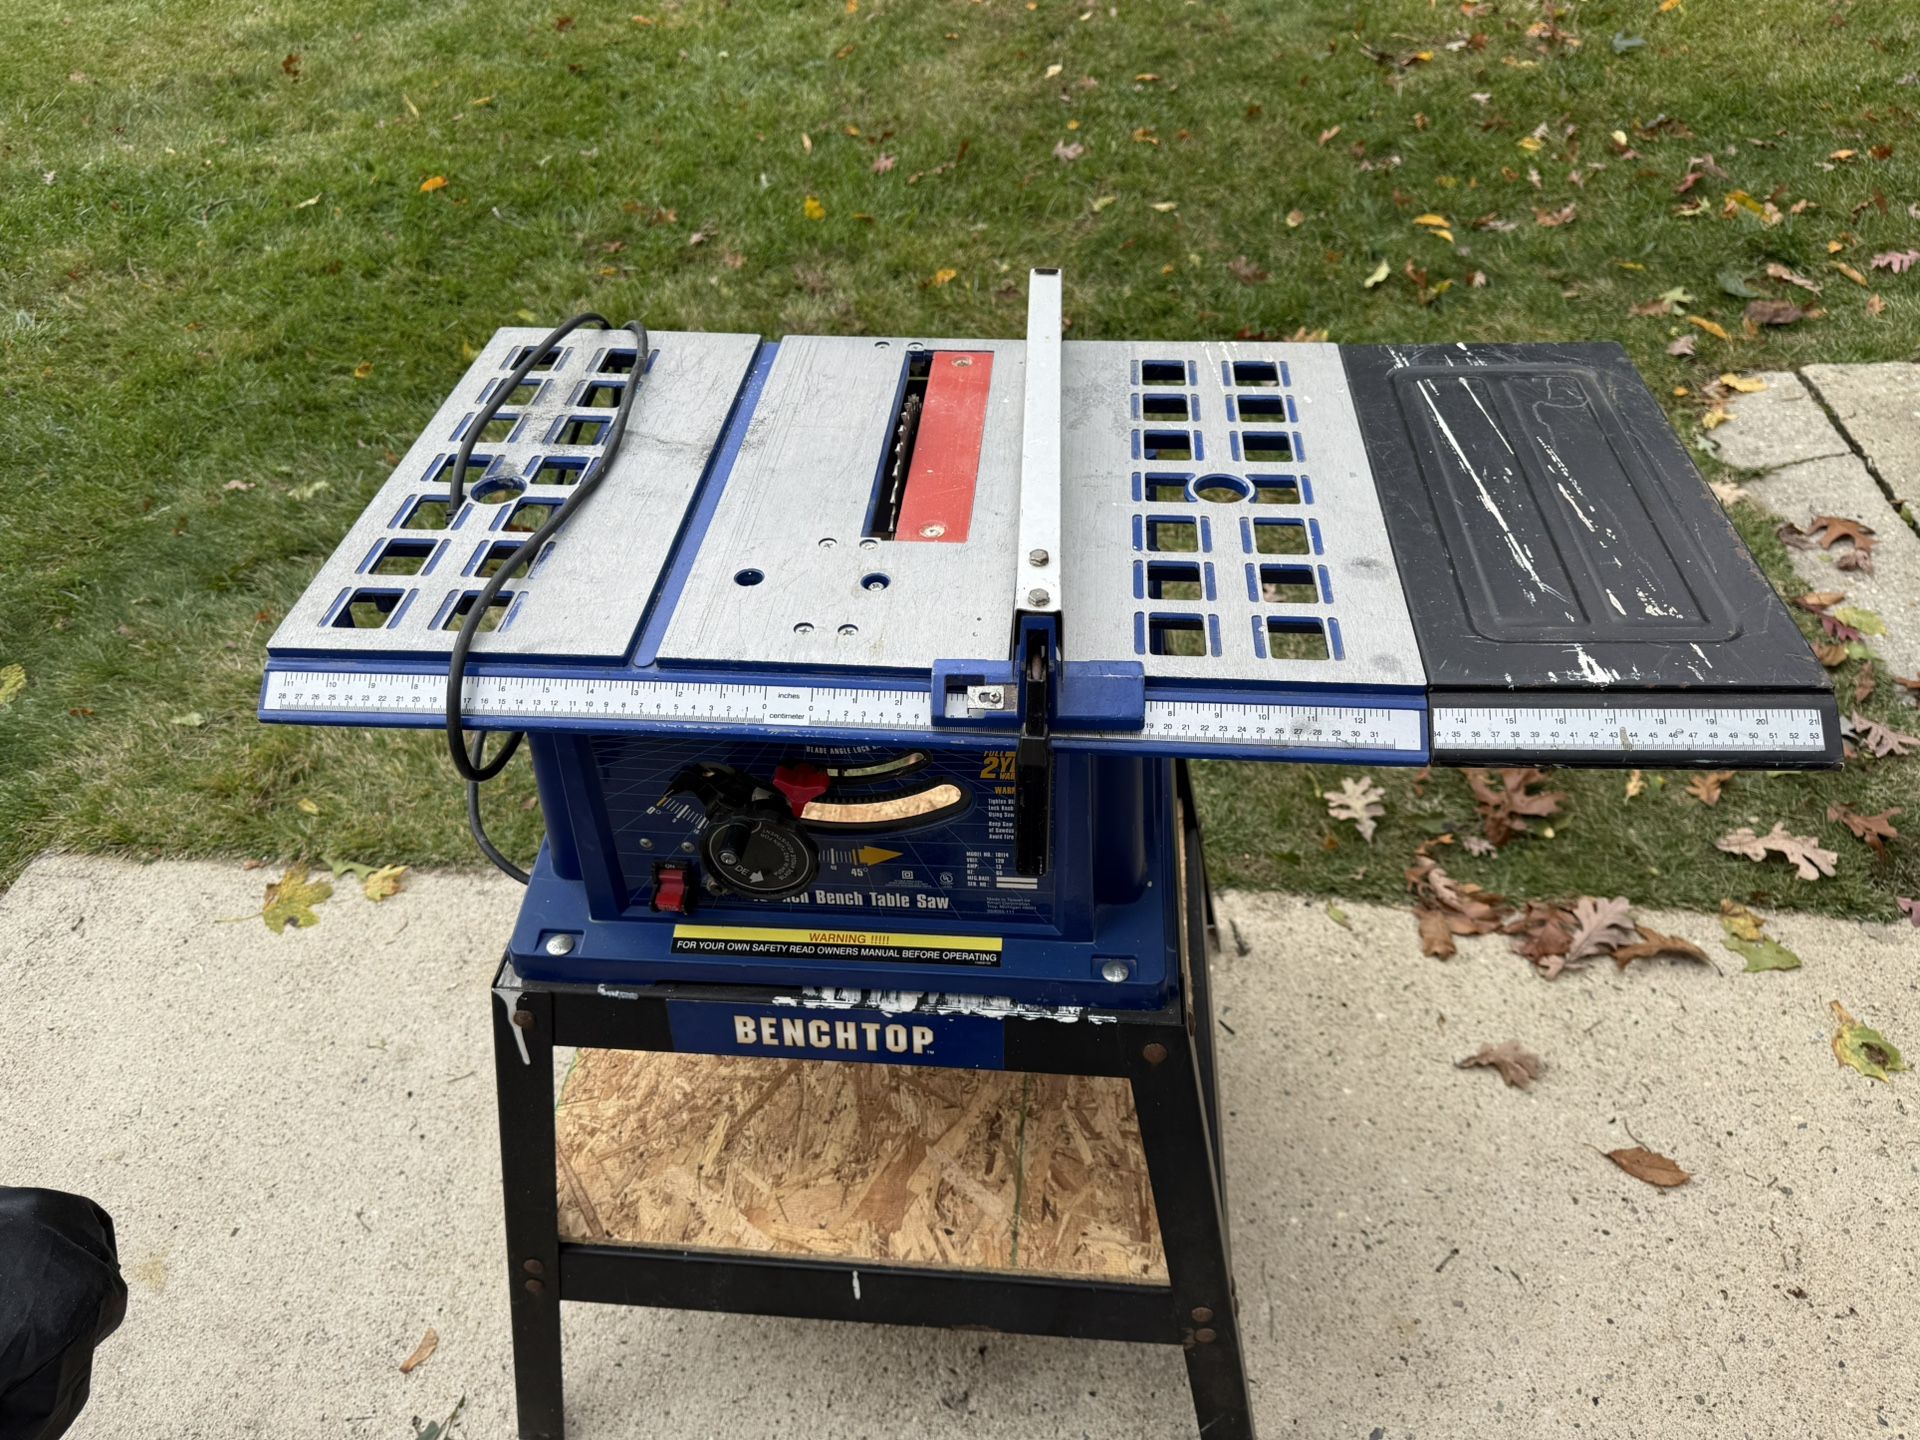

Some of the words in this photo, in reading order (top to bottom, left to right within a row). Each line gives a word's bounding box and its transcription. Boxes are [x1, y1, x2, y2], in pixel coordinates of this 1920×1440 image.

[806, 746, 827, 754] BLADE
[815, 890, 863, 906] Bench
[869, 892, 910, 908] Table
[917, 894, 949, 909] Saw
[809, 932, 866, 944] WARNING
[677, 940, 696, 949] FOR
[699, 941, 725, 950] YOUR
[727, 942, 750, 951] OWN
[752, 944, 787, 953] SAFETY
[789, 945, 814, 954] READ
[817, 947, 859, 956] OWNERS
[861, 948, 899, 958] MANUAL
[902, 950, 940, 960] BEFORE
[942, 951, 997, 962] OPERATING
[734, 1015, 934, 1054] BENCHTOP
